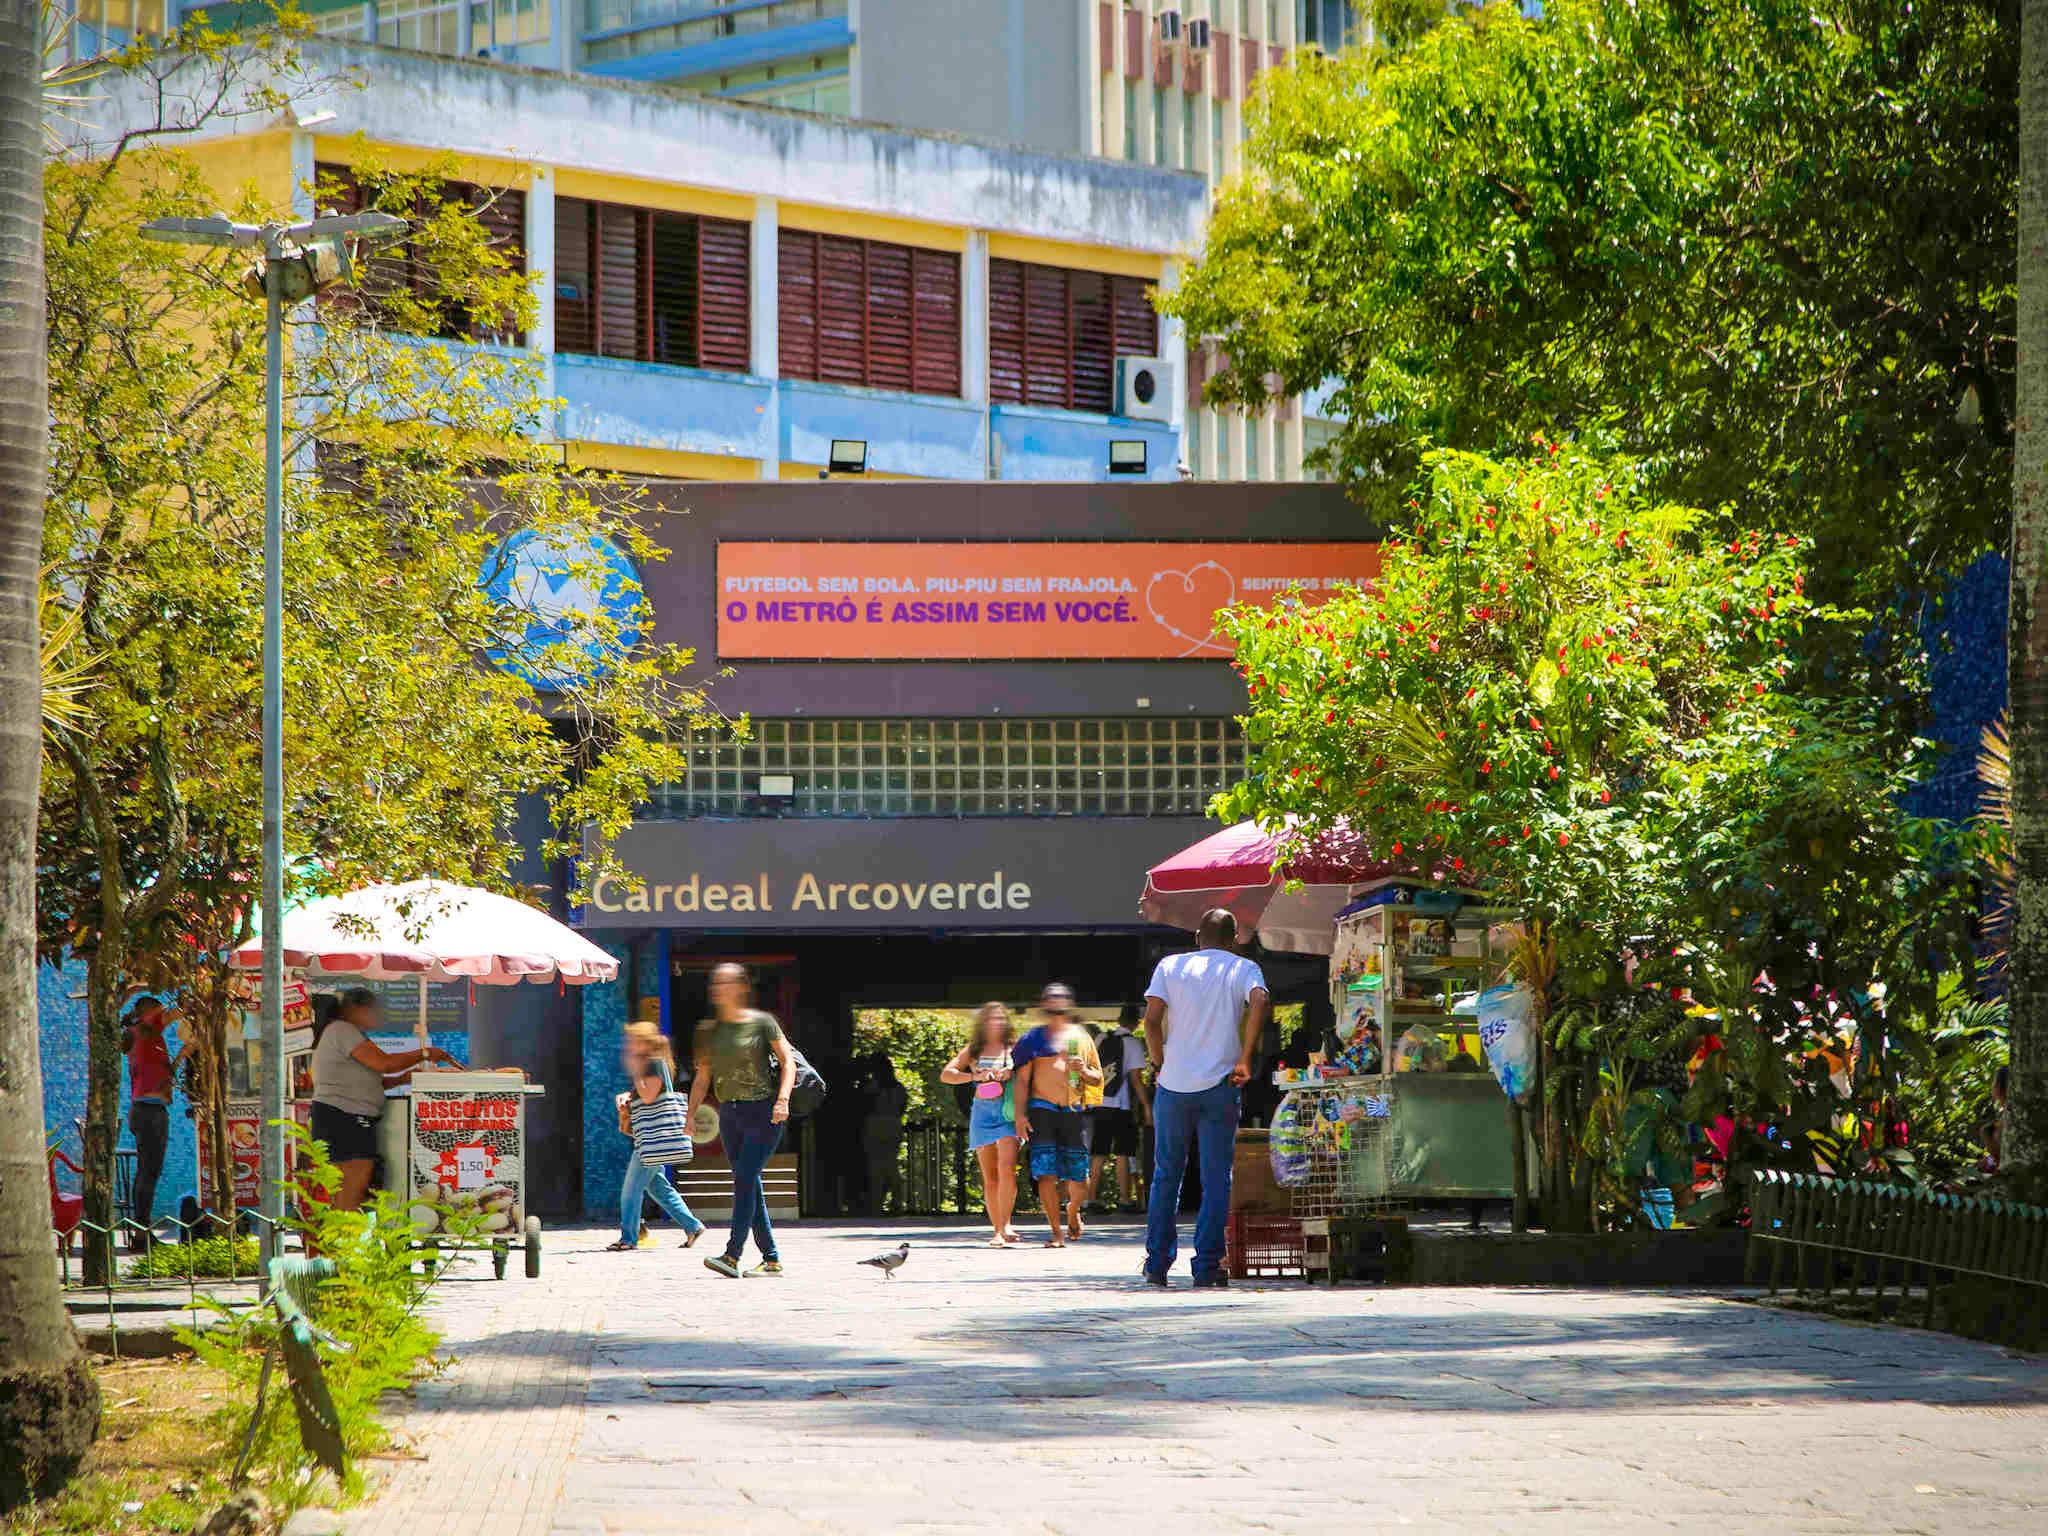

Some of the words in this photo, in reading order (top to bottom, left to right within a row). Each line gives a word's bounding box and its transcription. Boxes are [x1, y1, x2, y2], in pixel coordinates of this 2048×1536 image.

[725, 577, 813, 593] FUTEBOL
[818, 577, 859, 593] SEM
[864, 577, 920, 593] BOLA.
[925, 577, 996, 593] PIU-PIU
[1001, 577, 1042, 593] SEM
[1047, 577, 1138, 593] FRAJOLA.
[726, 601, 748, 623] O
[756, 595, 858, 623] METRÔ
[866, 595, 883, 623] É
[891, 601, 979, 623] ASSIM
[987, 601, 1046, 623] SEM
[1054, 595, 1139, 623] VOCÊ.
[593, 873, 773, 913] Cardeal
[791, 872, 1032, 911] Arcoverde
[416, 1100, 518, 1118] BISCOITOS
[460, 1161, 484, 1174] 1,50
